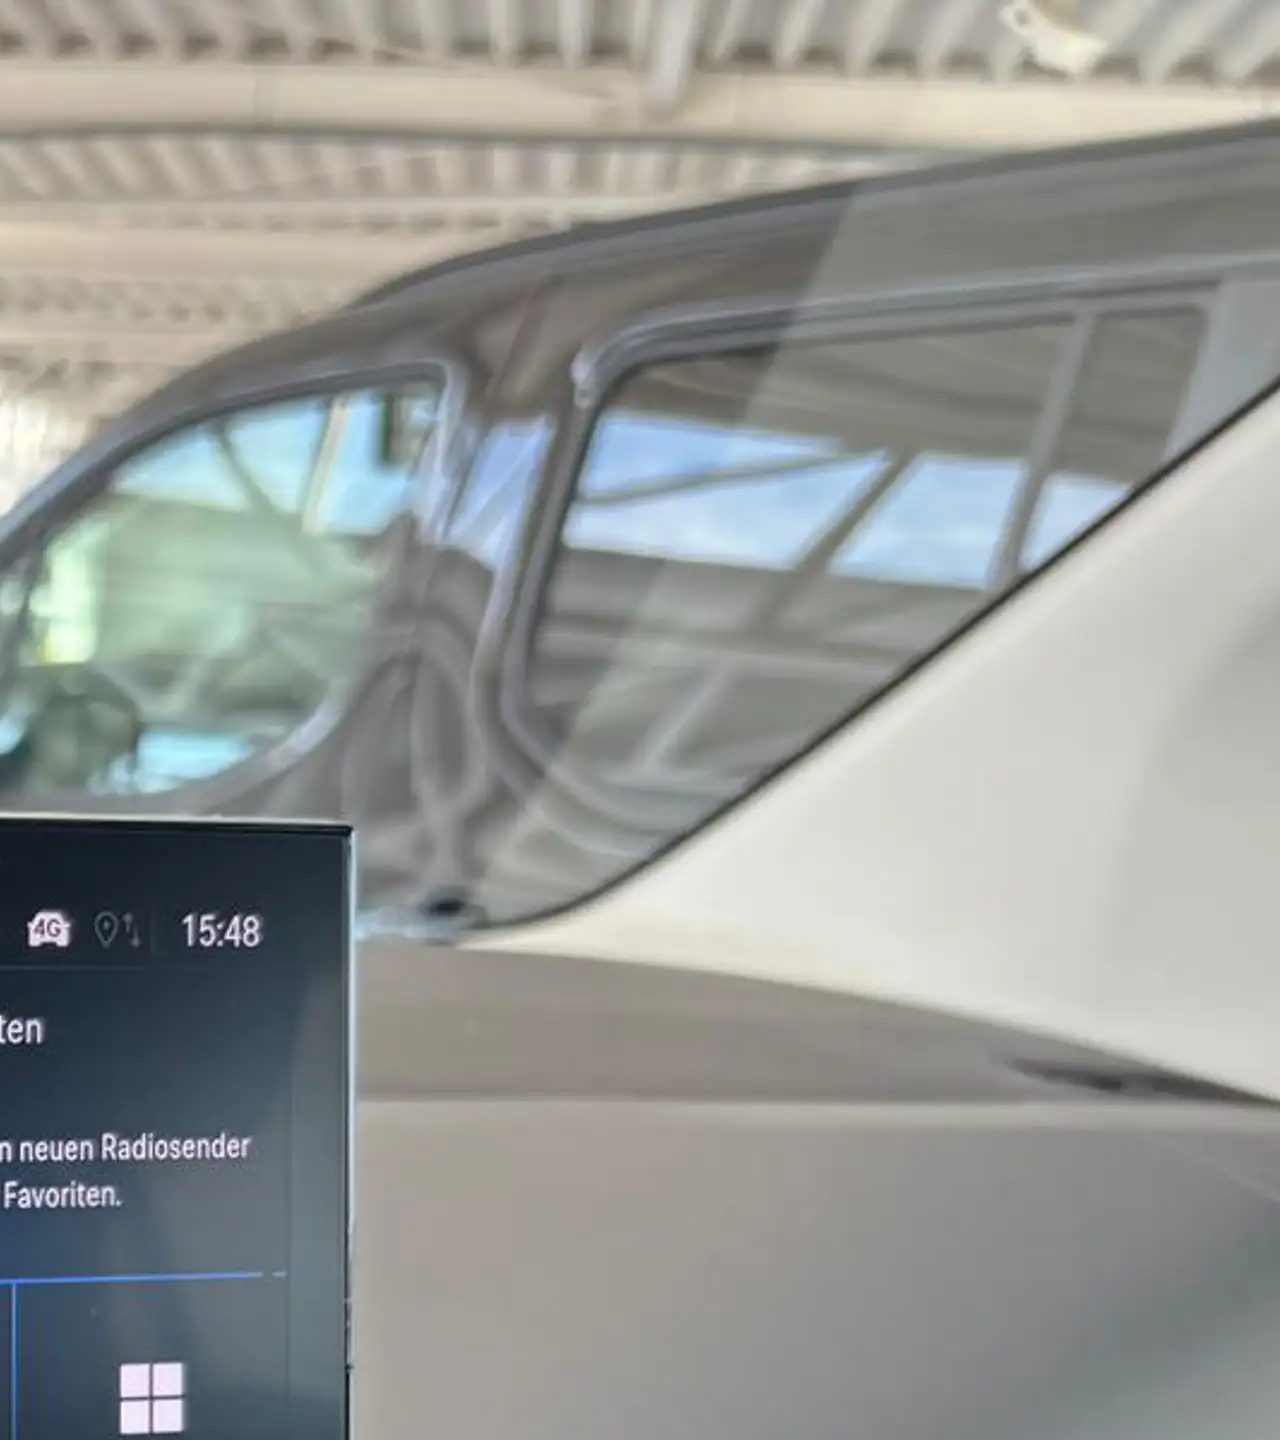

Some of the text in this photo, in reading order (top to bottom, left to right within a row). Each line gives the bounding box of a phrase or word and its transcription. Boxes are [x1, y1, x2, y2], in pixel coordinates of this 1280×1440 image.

[181, 913, 262, 948] 15:48
[19, 1139, 96, 1162] neuen
[101, 1132, 252, 1160] Radiosender
[4, 1180, 122, 1208] Favoriten.
